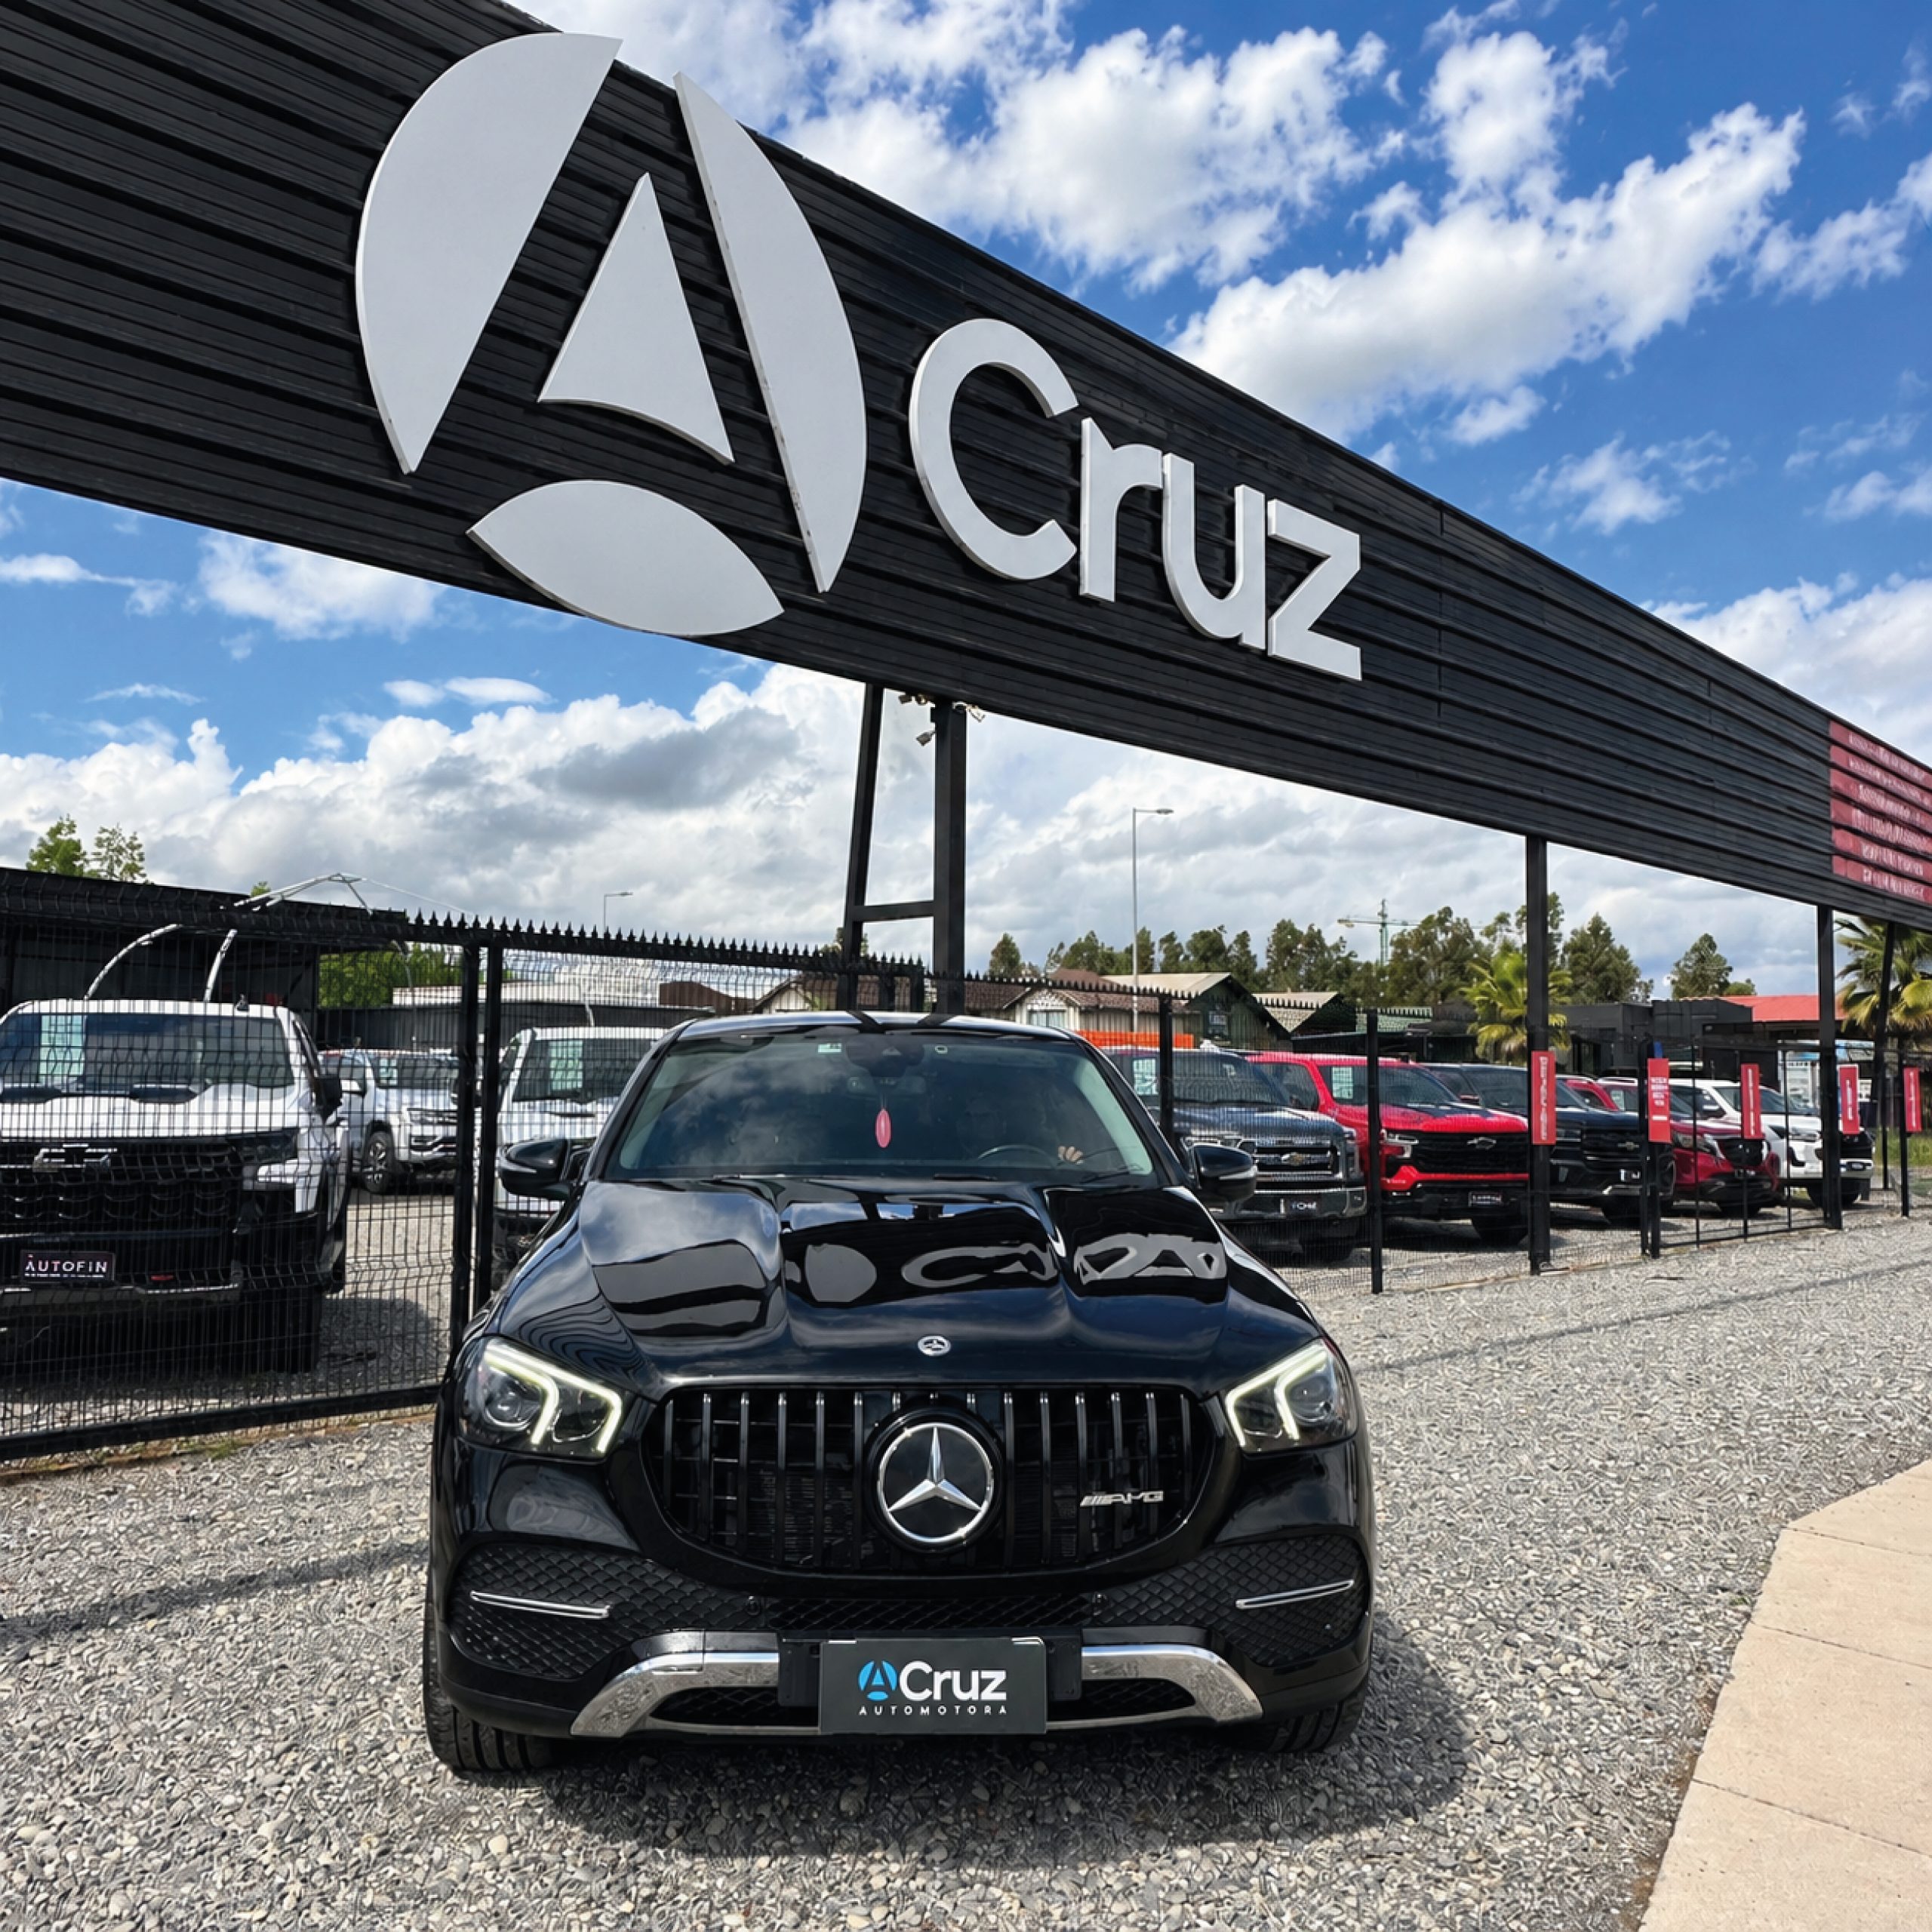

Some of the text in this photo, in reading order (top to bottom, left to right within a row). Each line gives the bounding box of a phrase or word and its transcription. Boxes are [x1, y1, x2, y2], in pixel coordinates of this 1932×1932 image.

[909, 318, 1361, 681] Cruz
[25, 1254, 108, 1273] AUTOFIN
[900, 1660, 1007, 1701] Cruz
[859, 1705, 1007, 1715] AUTOMOTORA
